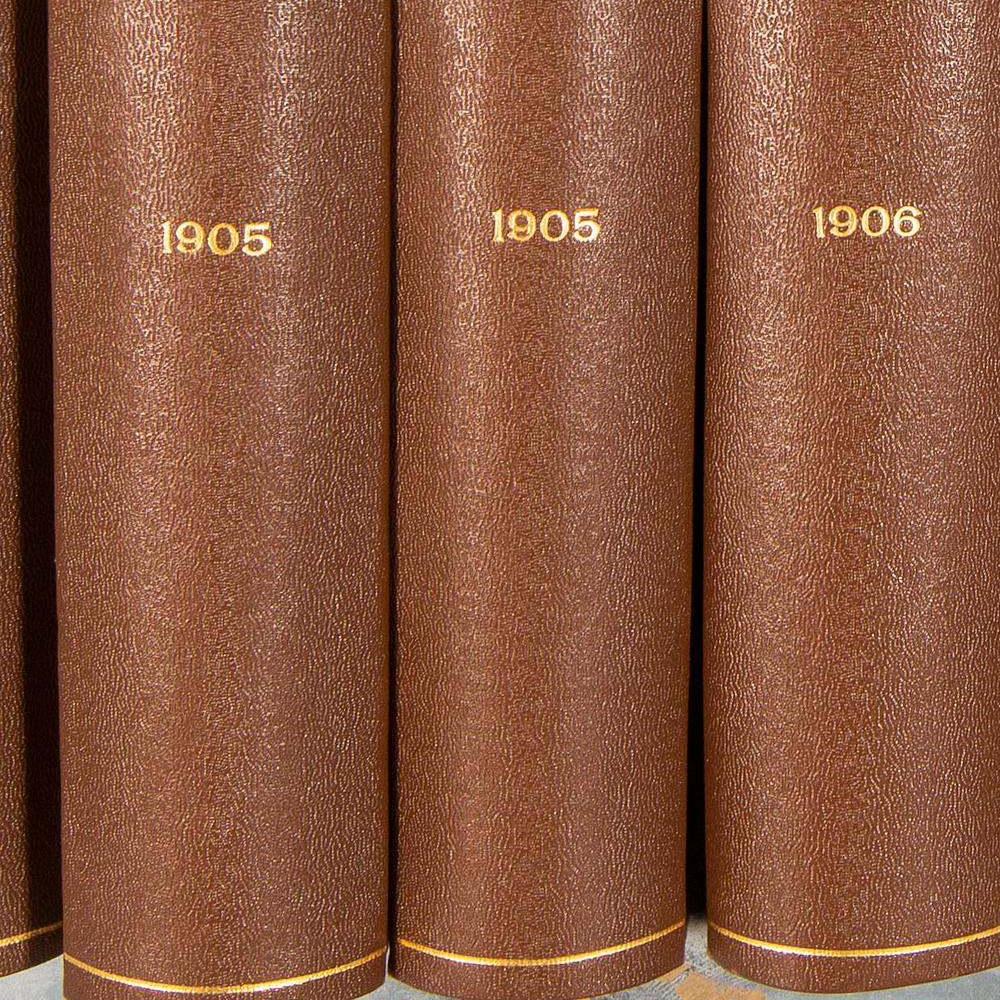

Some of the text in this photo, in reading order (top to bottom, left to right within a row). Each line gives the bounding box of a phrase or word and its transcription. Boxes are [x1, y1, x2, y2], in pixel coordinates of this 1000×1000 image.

[160, 220, 273, 257] 1905
[492, 208, 601, 243] 1905
[813, 205, 922, 238] 1906
